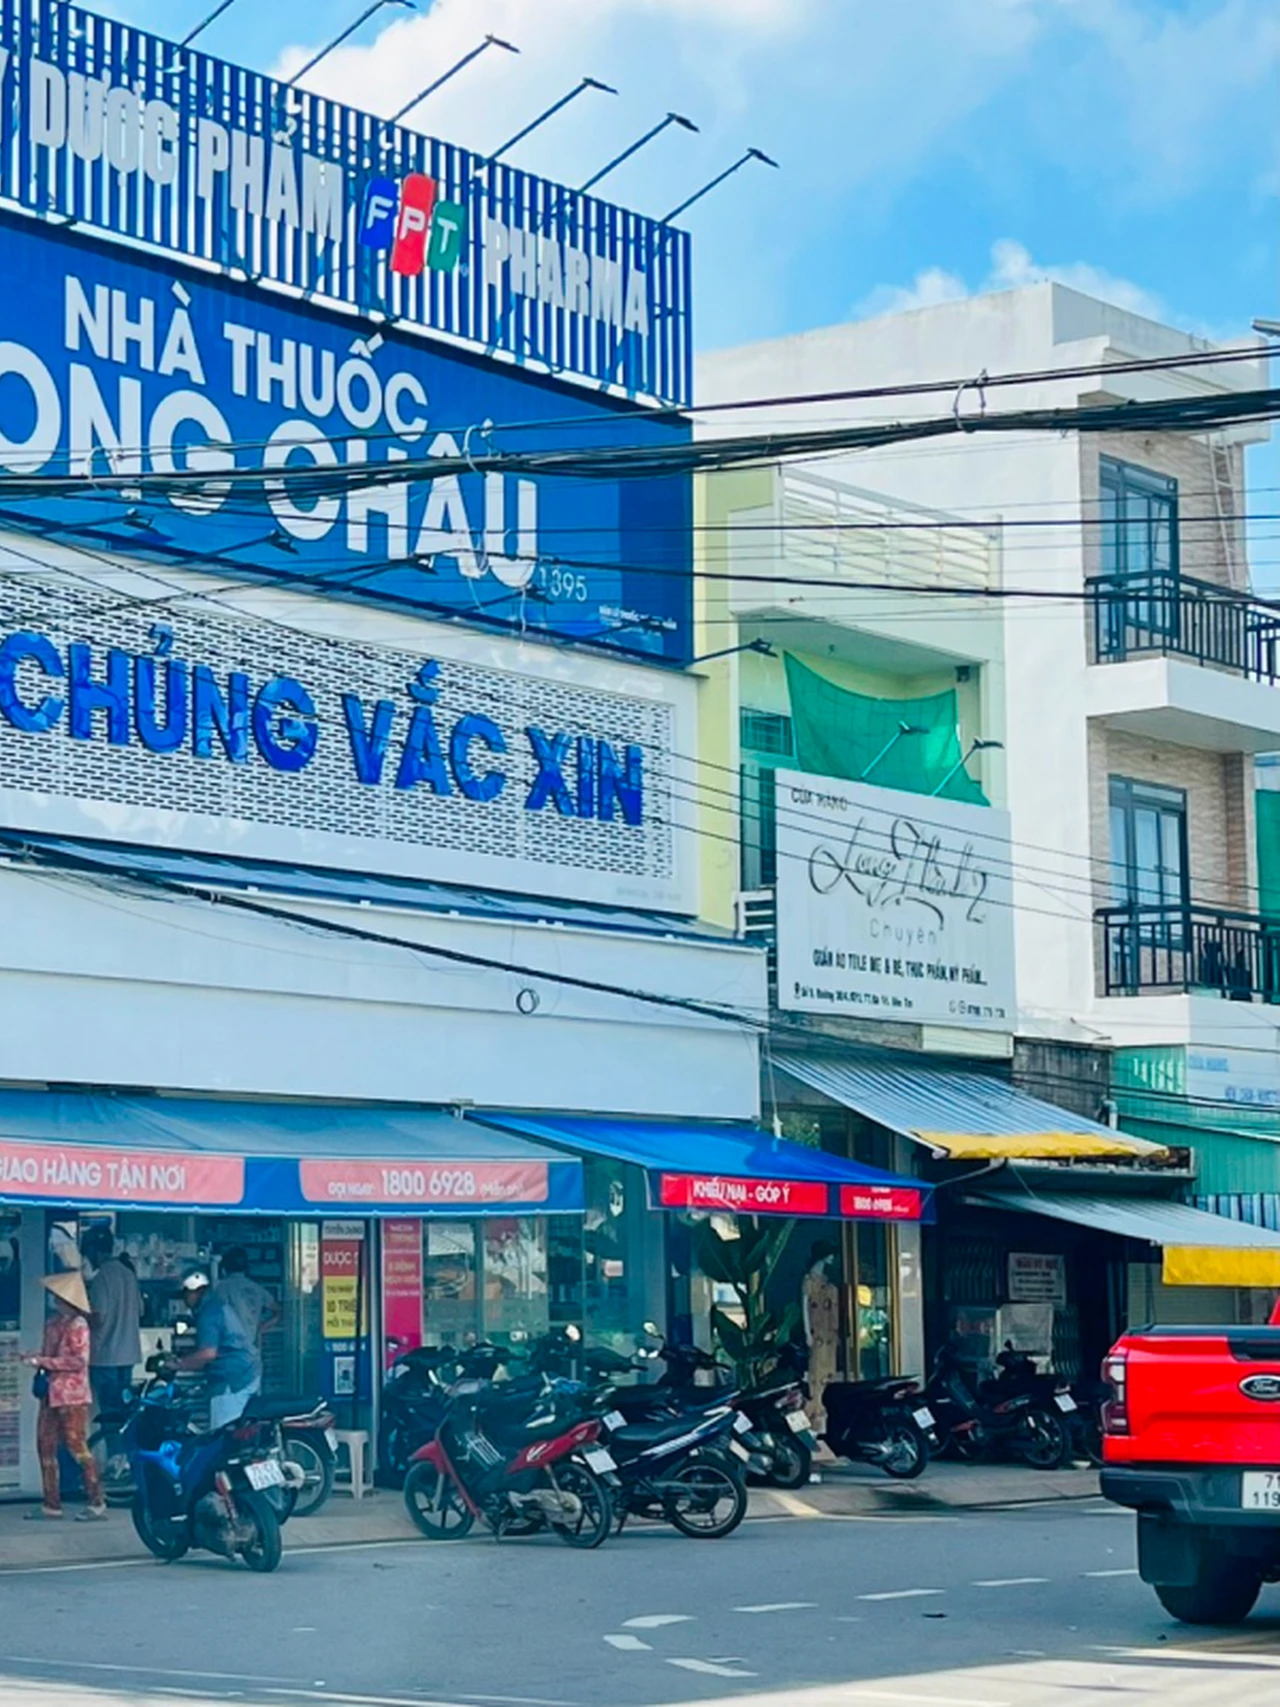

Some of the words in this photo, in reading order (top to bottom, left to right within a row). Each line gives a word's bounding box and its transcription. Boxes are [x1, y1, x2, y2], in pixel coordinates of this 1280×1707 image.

[483, 217, 650, 336] PHARMA
[64, 274, 207, 385] NHÀ
[223, 332, 430, 443] THUỐC
[263, 417, 538, 589] CHÂU
[540, 565, 587, 602] 1395
[341, 657, 509, 803] VẮC
[523, 726, 644, 827] XIN
[43, 1153, 102, 1187] HÀNG
[107, 1157, 146, 1195] TẬN
[381, 1170, 425, 1196] 1800
[429, 1171, 475, 1196] 6928
[755, 1181, 780, 1203] GÓP
[782, 1182, 790, 1204] Ý
